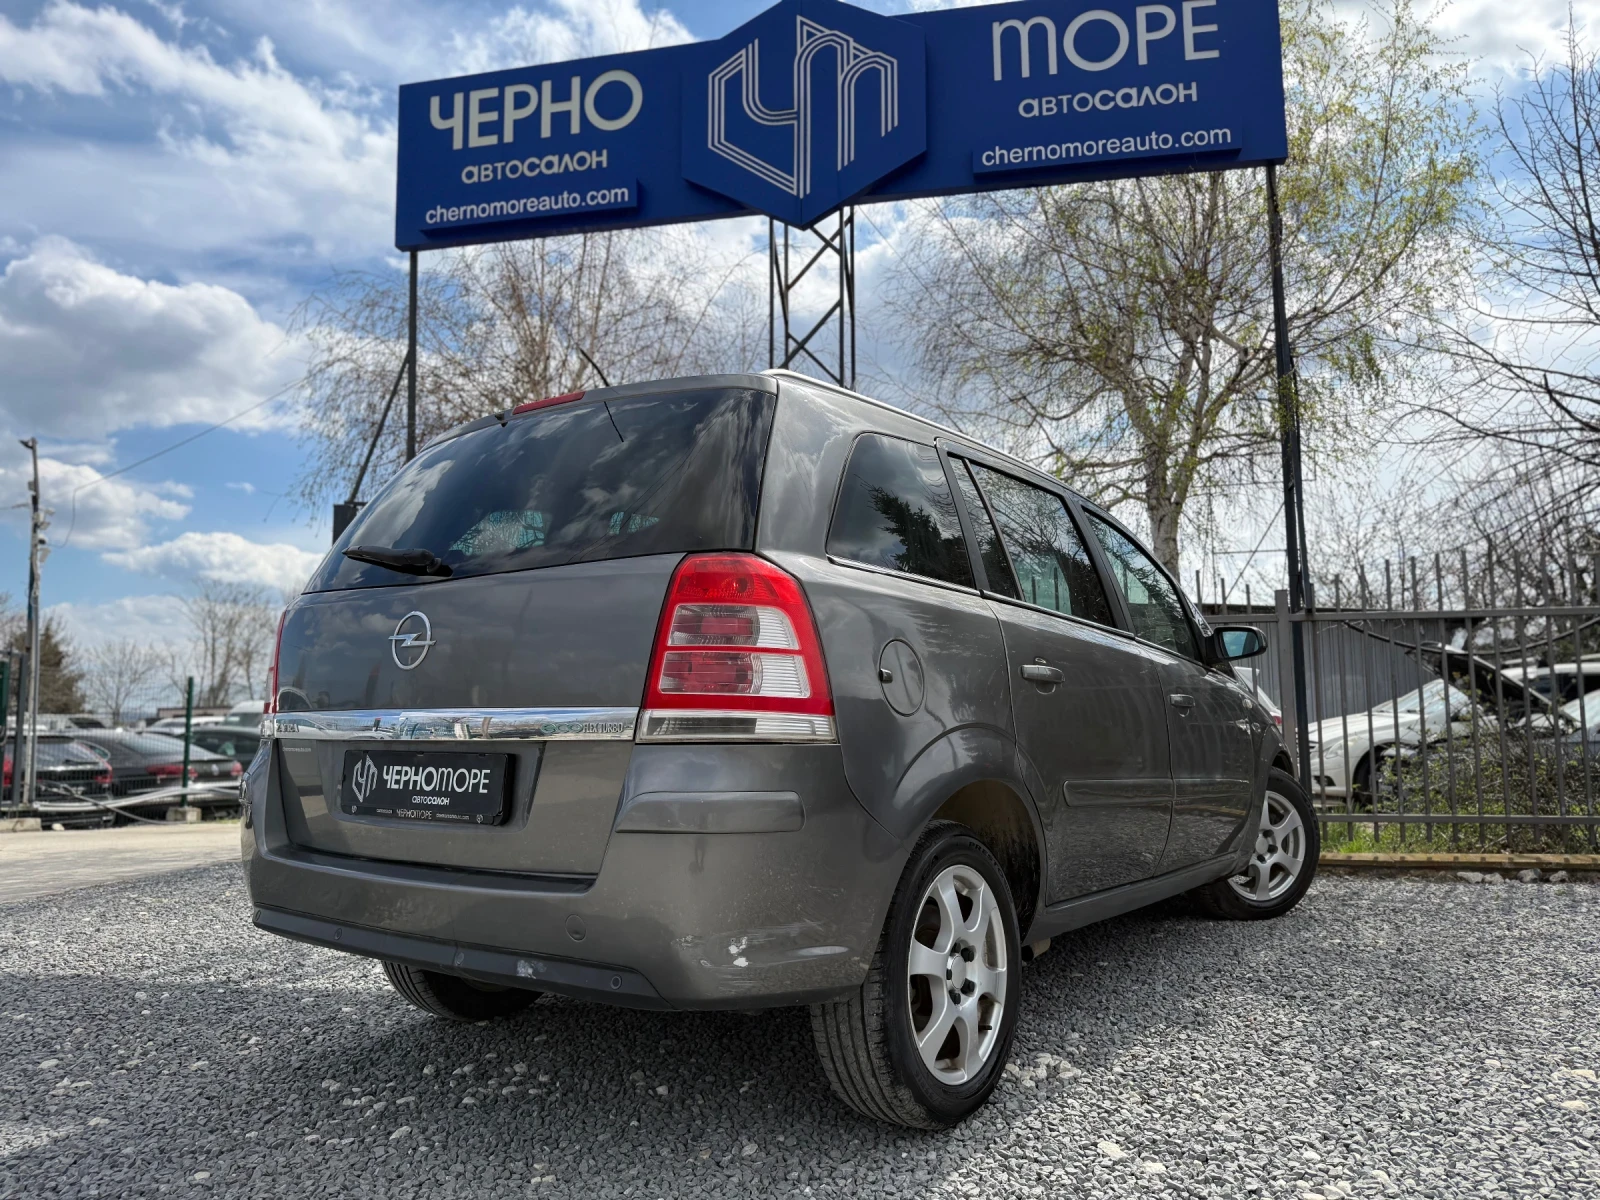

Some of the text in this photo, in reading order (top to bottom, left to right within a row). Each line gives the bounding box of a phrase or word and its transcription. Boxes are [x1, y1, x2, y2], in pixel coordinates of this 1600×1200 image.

[992, 0, 1220, 81] МОРЕ
[429, 69, 644, 150] ЧЕРНО
[1018, 81, 1198, 118] автосалон
[981, 128, 1232, 166] chernomoreauto.com
[461, 148, 608, 184] автосалон
[425, 187, 629, 224] chernomoreauto.com
[383, 765, 491, 794] ЧЕРНОМОРЕ
